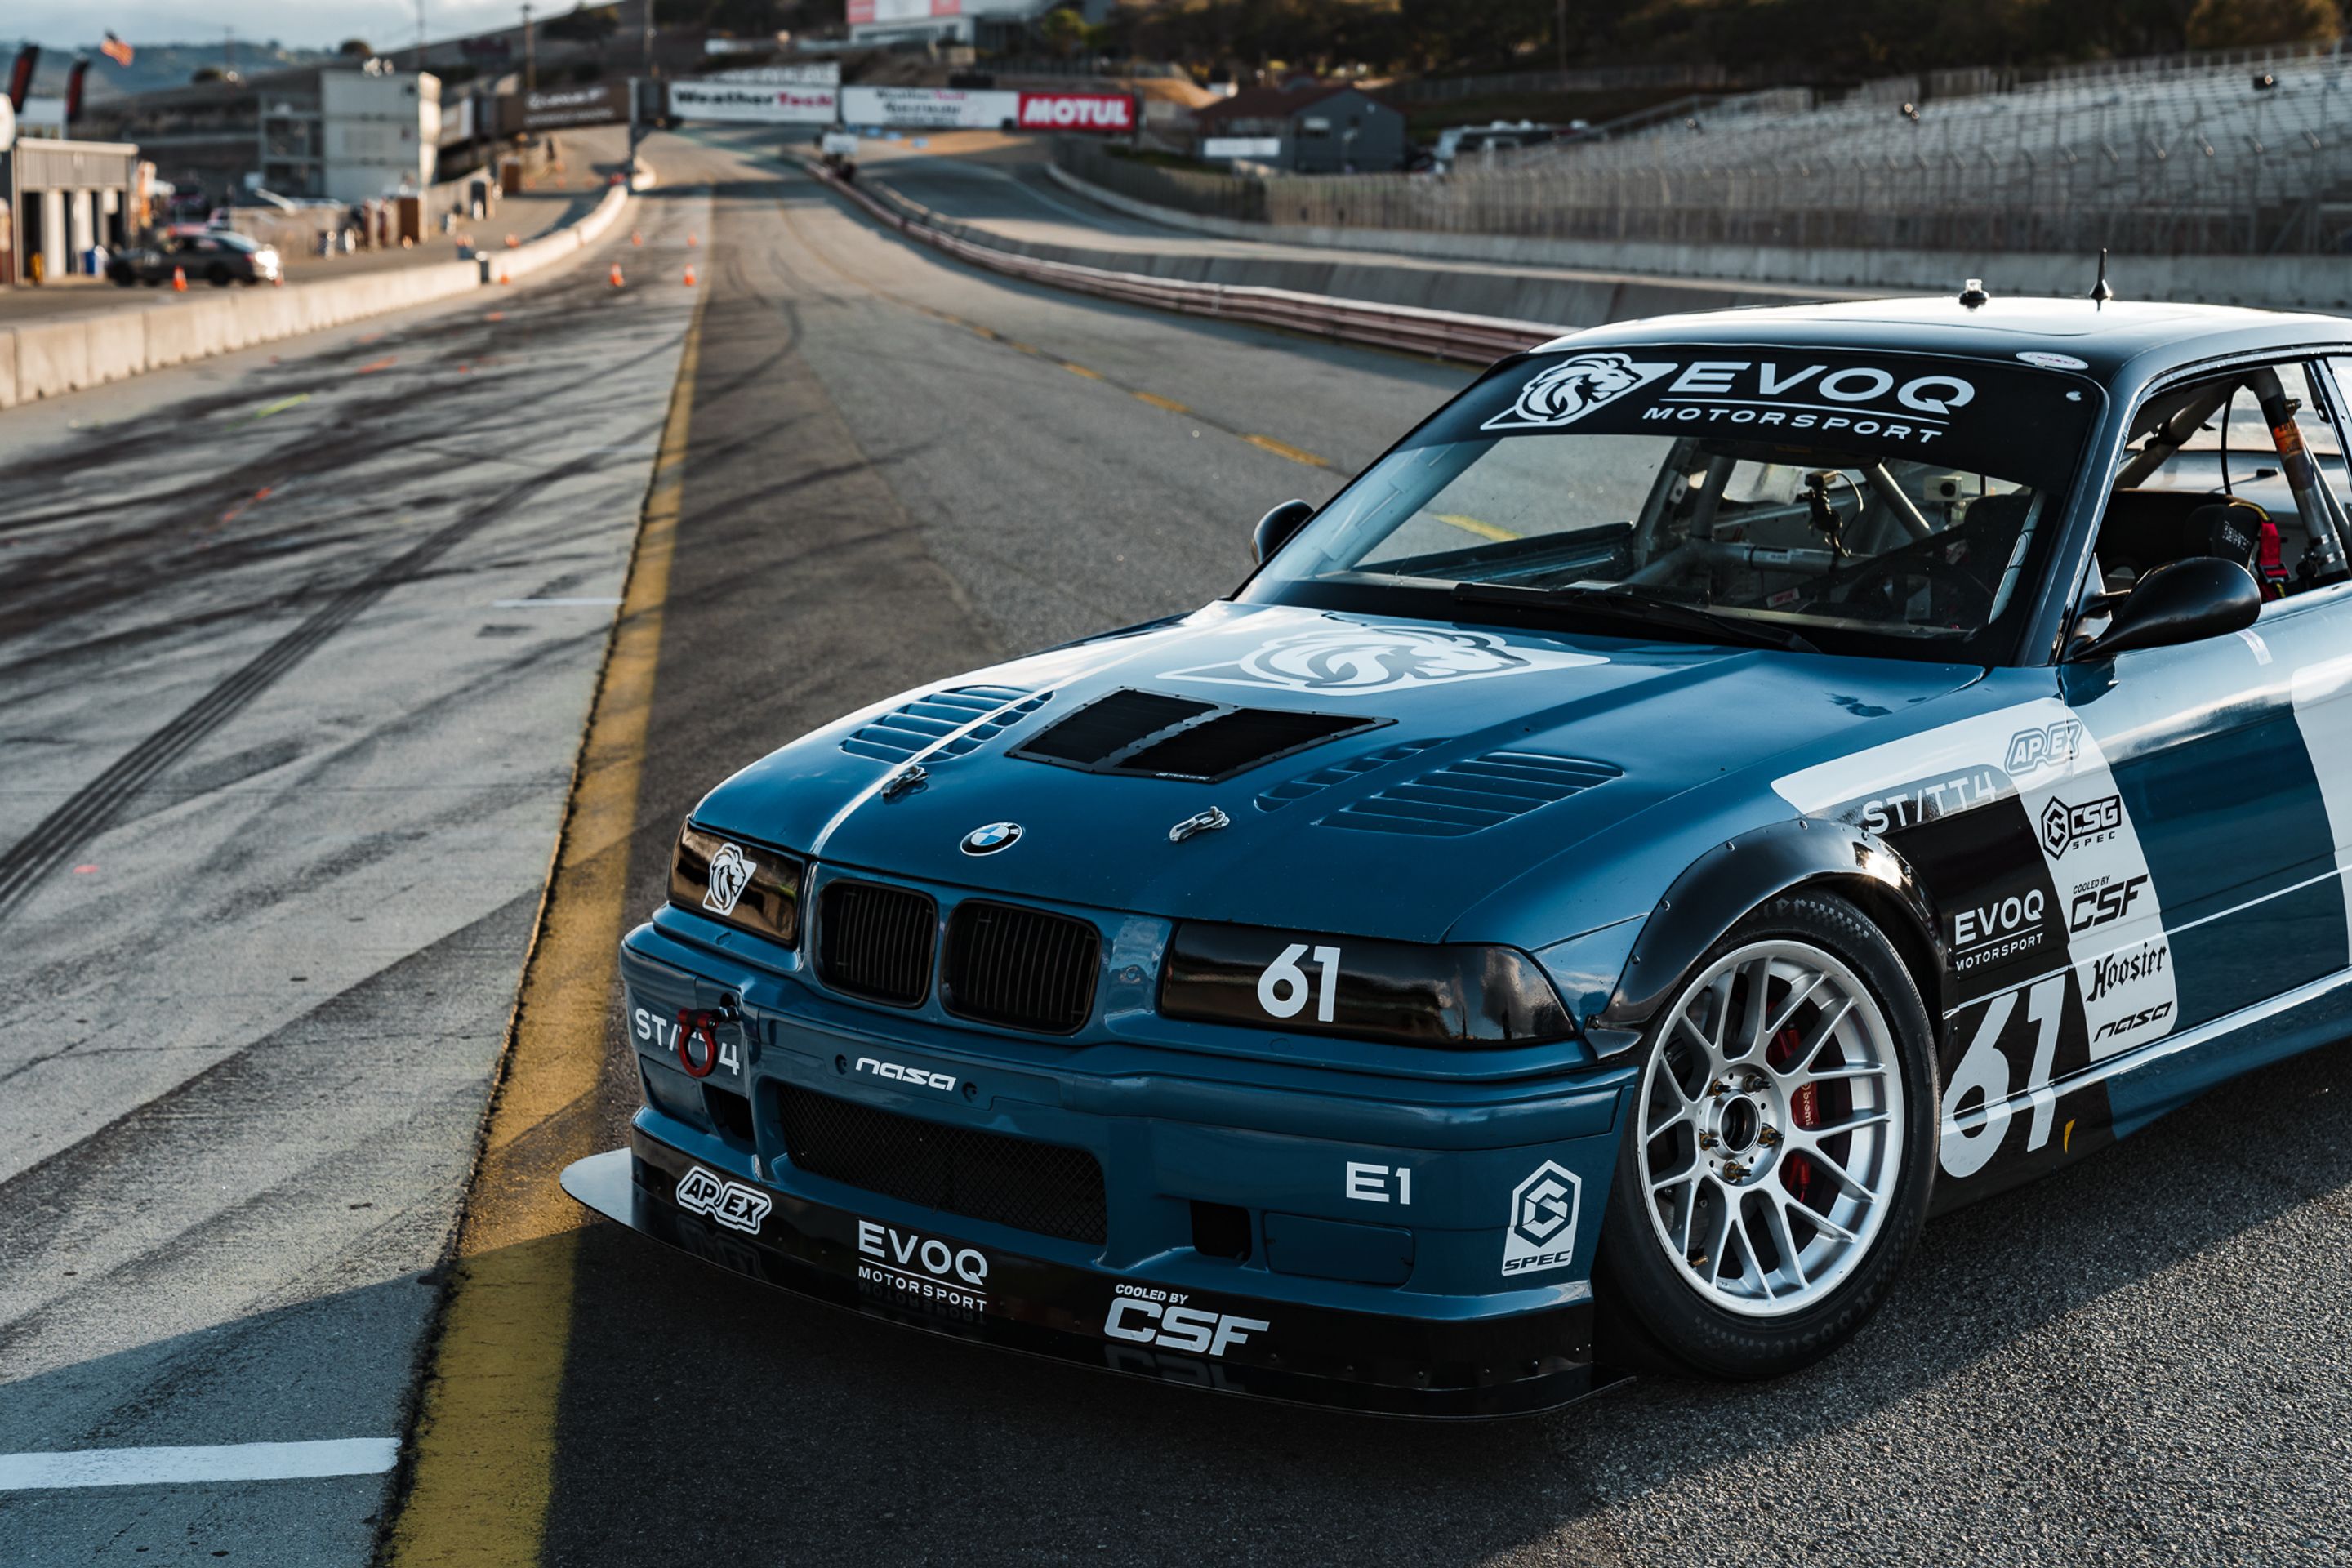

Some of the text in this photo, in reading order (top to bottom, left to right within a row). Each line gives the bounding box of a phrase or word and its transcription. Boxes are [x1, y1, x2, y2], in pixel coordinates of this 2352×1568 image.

[1023, 96, 1129, 126] MOTUL
[1667, 361, 1976, 415] EVOQ
[1642, 407, 1943, 443] MOTORSPORT
[1861, 770, 1998, 835] ST/TT4
[2070, 797, 2119, 837] CSG
[2072, 831, 2116, 850] SPEC
[2069, 873, 2149, 934] CSF
[2073, 874, 2111, 895] COOLED BY
[1954, 889, 2045, 947] EVOQ
[1955, 932, 2044, 972] MOTORSPORT
[2085, 941, 2167, 1003] Hoosier
[1257, 942, 1341, 1023] 61
[635, 1007, 741, 1076] ST/4
[2092, 1000, 2173, 1043] nasa
[855, 1056, 956, 1092] nasa
[1939, 973, 2066, 1178] 61
[1346, 1160, 1411, 1205] E1
[858, 1219, 988, 1286] EVOQ
[1503, 1249, 1572, 1272] SPEC
[858, 1265, 987, 1312] MOTORSPORT
[1115, 1283, 1189, 1305] COOLED BY
[1103, 1296, 1271, 1357] CSF
